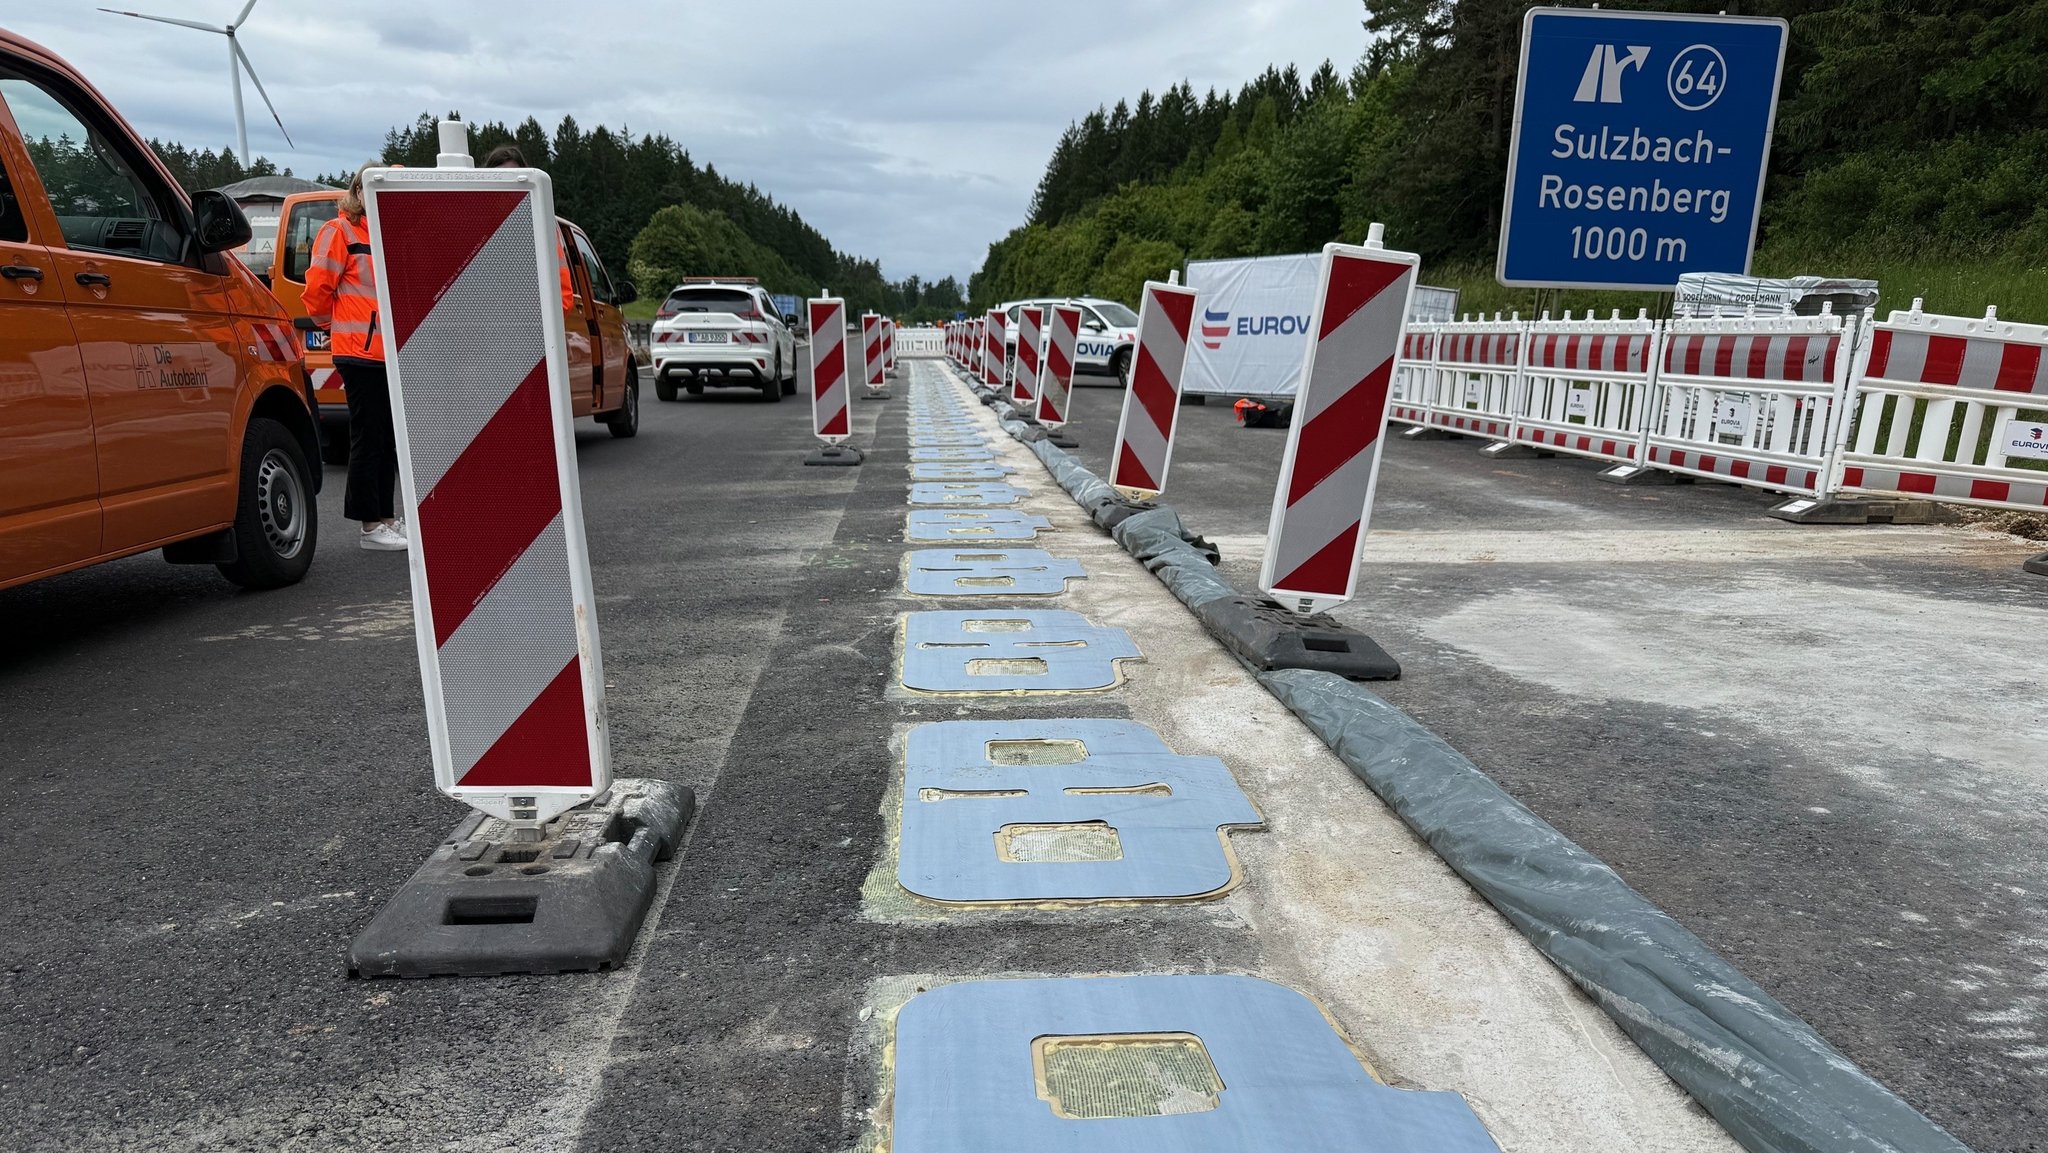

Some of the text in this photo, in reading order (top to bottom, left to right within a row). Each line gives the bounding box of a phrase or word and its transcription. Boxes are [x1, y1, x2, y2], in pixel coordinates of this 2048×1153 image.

[1674, 59, 1718, 96] 64
[1551, 123, 1732, 164] Sulzbach-
[1538, 174, 1731, 224] Rosenberg
[1571, 225, 1687, 262] 1000 m
[1236, 315, 1311, 335] EUROV
[153, 344, 172, 364] Die
[160, 368, 208, 387] Autobahn
